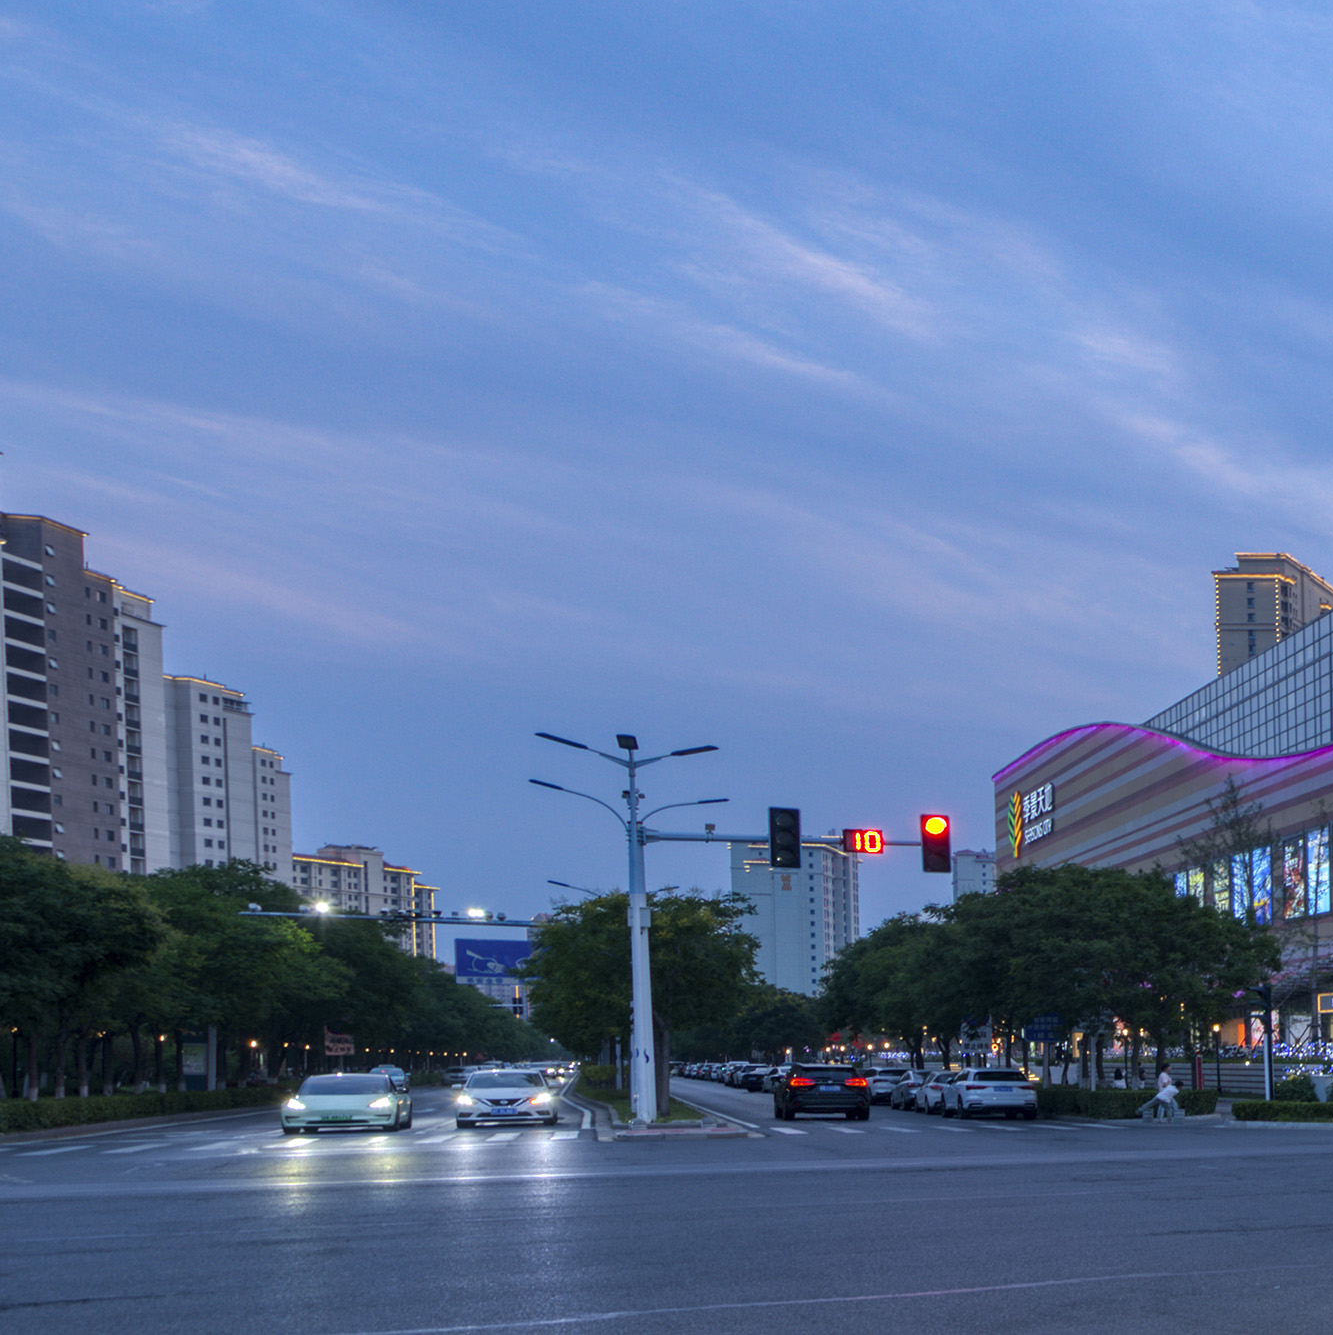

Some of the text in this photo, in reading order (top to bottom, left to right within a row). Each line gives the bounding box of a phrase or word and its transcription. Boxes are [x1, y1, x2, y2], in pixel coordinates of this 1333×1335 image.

[1022, 782, 1053, 823] 季景天地
[855, 831, 882, 853] 10
